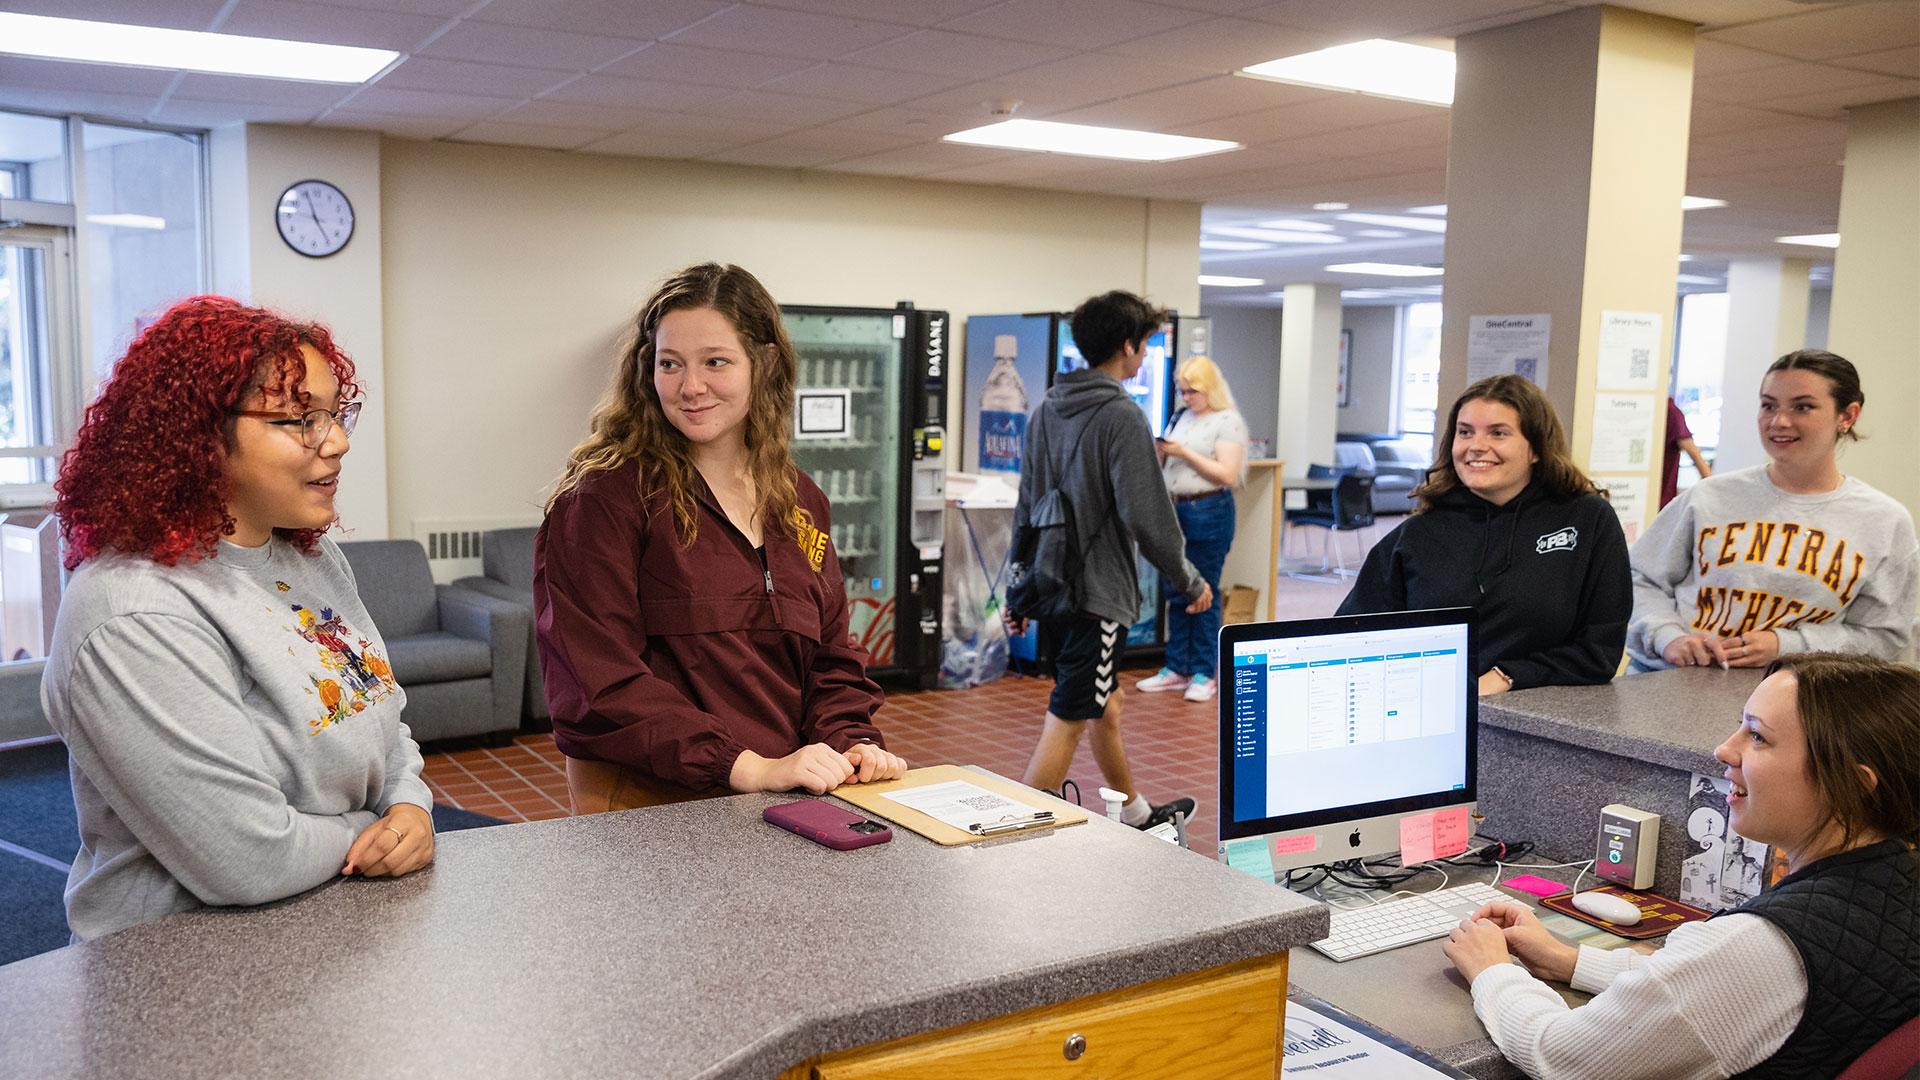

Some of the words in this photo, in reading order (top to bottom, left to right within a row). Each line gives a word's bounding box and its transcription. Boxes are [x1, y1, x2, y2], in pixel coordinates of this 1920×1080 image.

[1486, 320, 1533, 328] OneCentral
[1547, 532, 1569, 549] PB
[1698, 521, 1864, 606] CENTRAL
[1314, 1056, 1350, 1068] Resource
[1346, 1051, 1370, 1061] Binder
